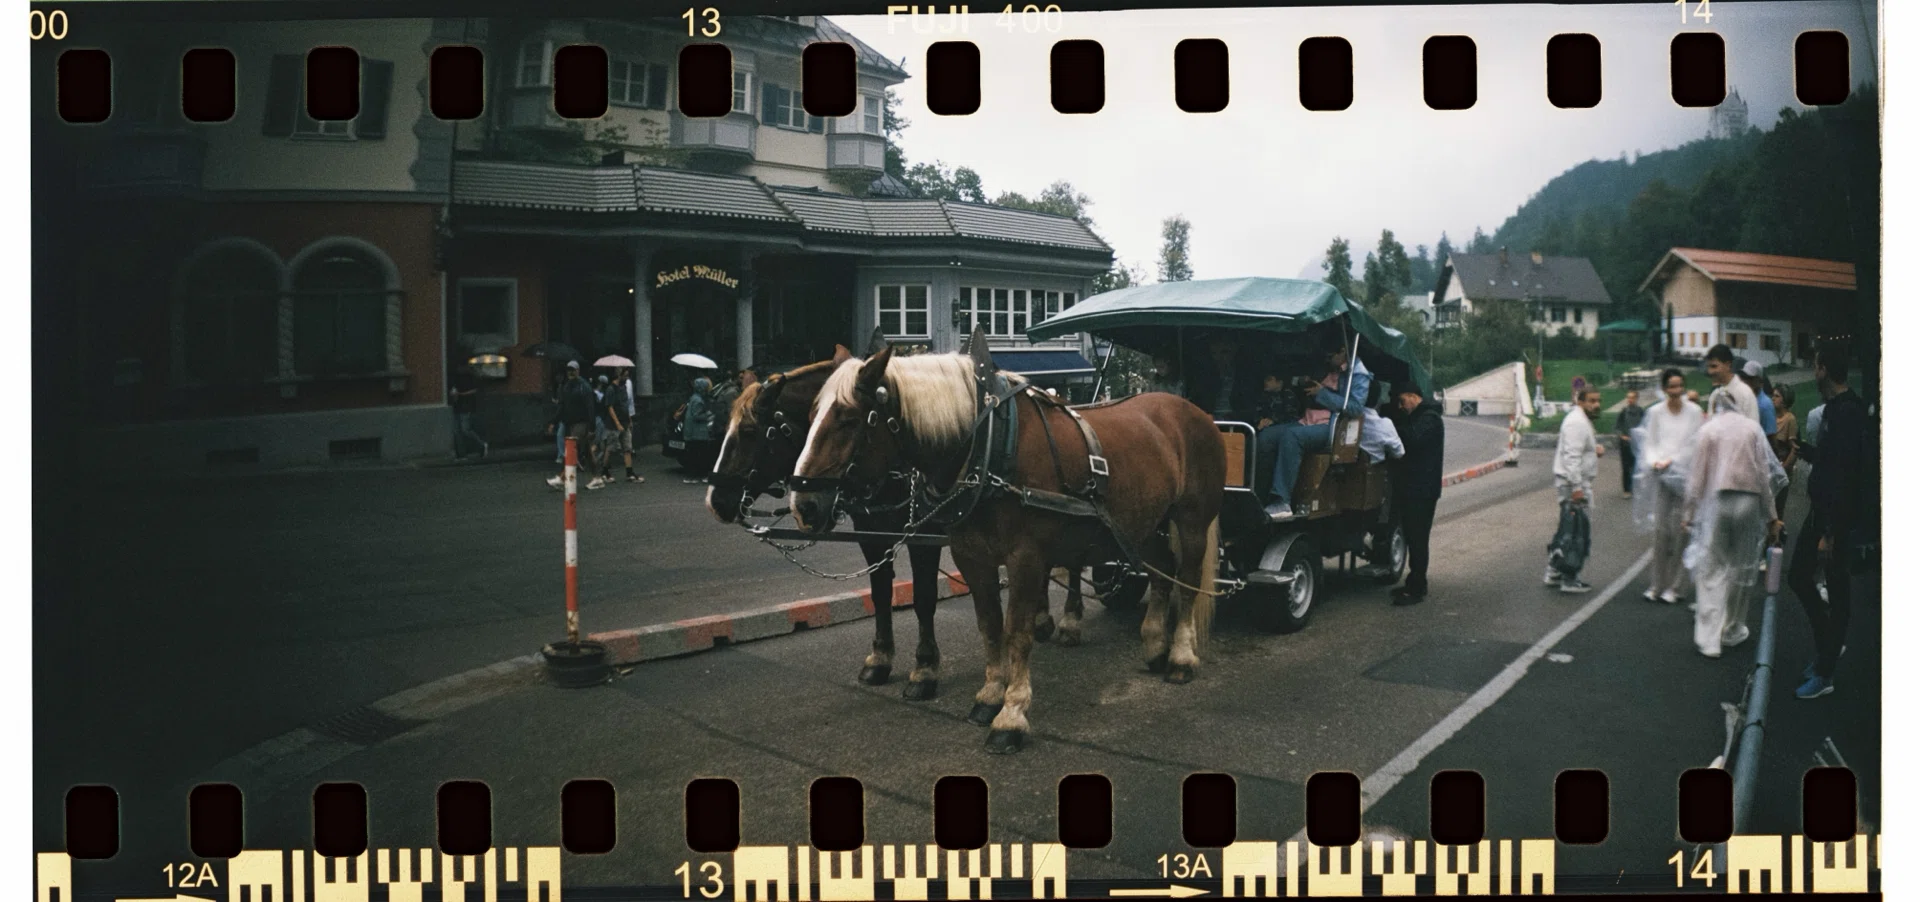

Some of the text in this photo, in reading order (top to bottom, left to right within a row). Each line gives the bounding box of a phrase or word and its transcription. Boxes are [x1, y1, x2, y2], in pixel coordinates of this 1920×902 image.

[682, 7, 721, 37] 13
[887, 4, 1063, 35] FUJI 400
[1674, 0, 1713, 24] 14
[656, 264, 739, 289] Hotel Müller
[163, 862, 219, 888] 12A
[674, 861, 725, 899] 13
[1157, 853, 1213, 879] 13A
[1668, 849, 1718, 888] 14
